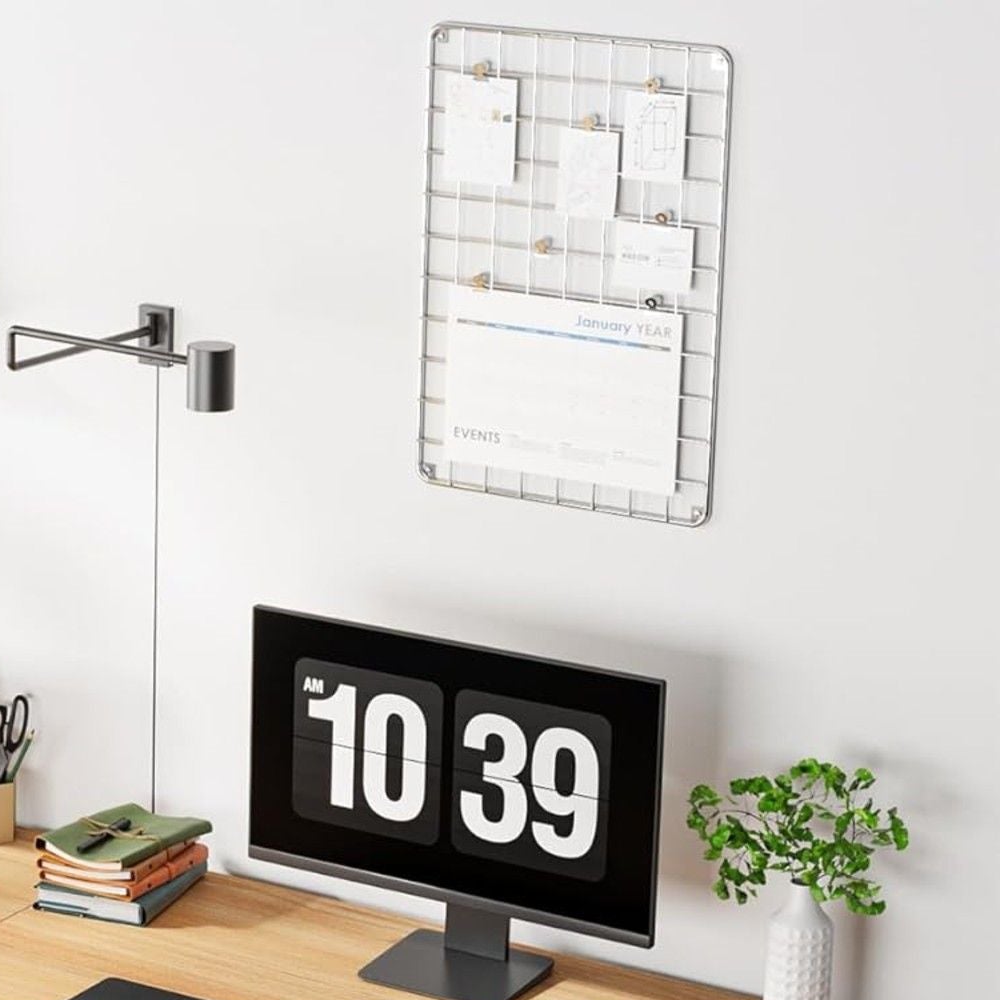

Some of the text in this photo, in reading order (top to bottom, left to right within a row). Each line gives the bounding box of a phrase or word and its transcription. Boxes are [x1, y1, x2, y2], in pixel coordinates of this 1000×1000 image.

[575, 314, 632, 335] January
[635, 322, 672, 339] YEAR
[453, 425, 501, 445] EVENTS
[303, 676, 324, 694] AM
[308, 683, 599, 860] 10 39
